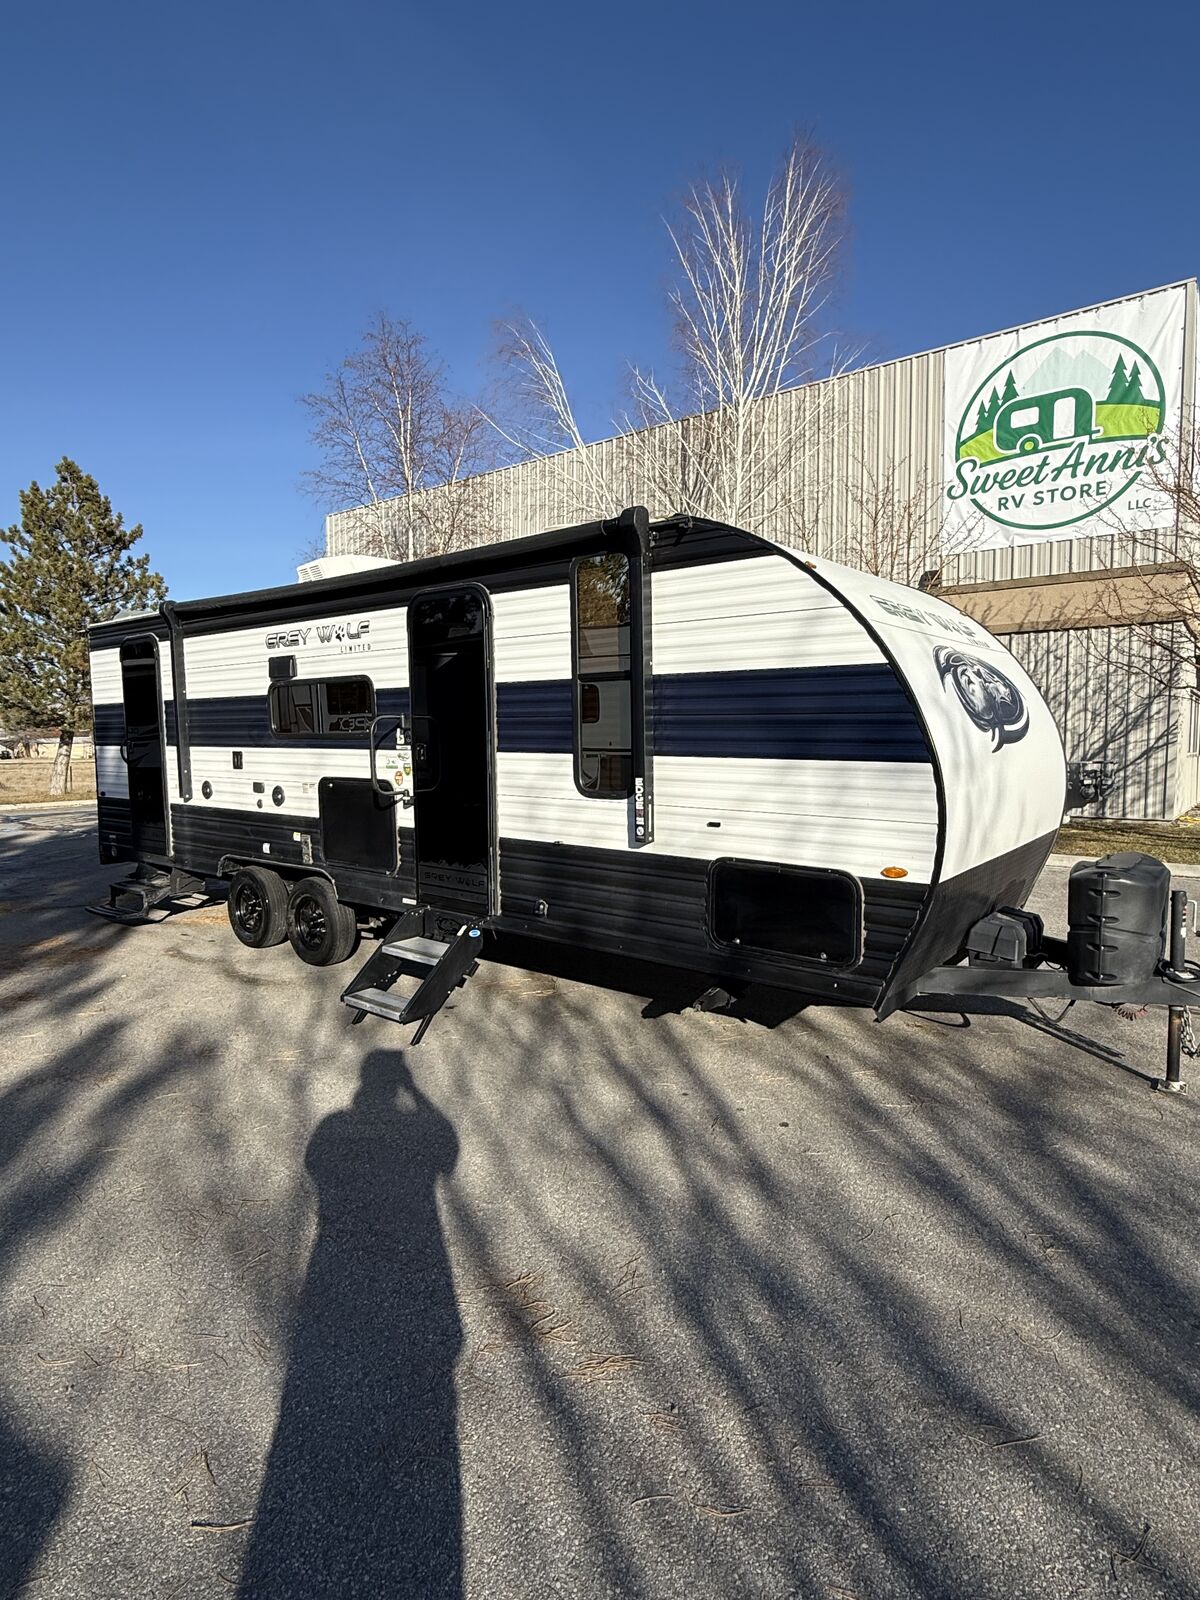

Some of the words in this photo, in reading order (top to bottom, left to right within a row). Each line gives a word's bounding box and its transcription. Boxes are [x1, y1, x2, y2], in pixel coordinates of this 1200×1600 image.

[946, 456, 1050, 500] Sweet
[1046, 436, 1169, 482] Anni's
[998, 494, 1025, 511] RV
[1032, 481, 1108, 506] STORE
[1128, 497, 1152, 511] LLC
[265, 628, 312, 650] GREY
[340, 643, 372, 654] LIMITED
